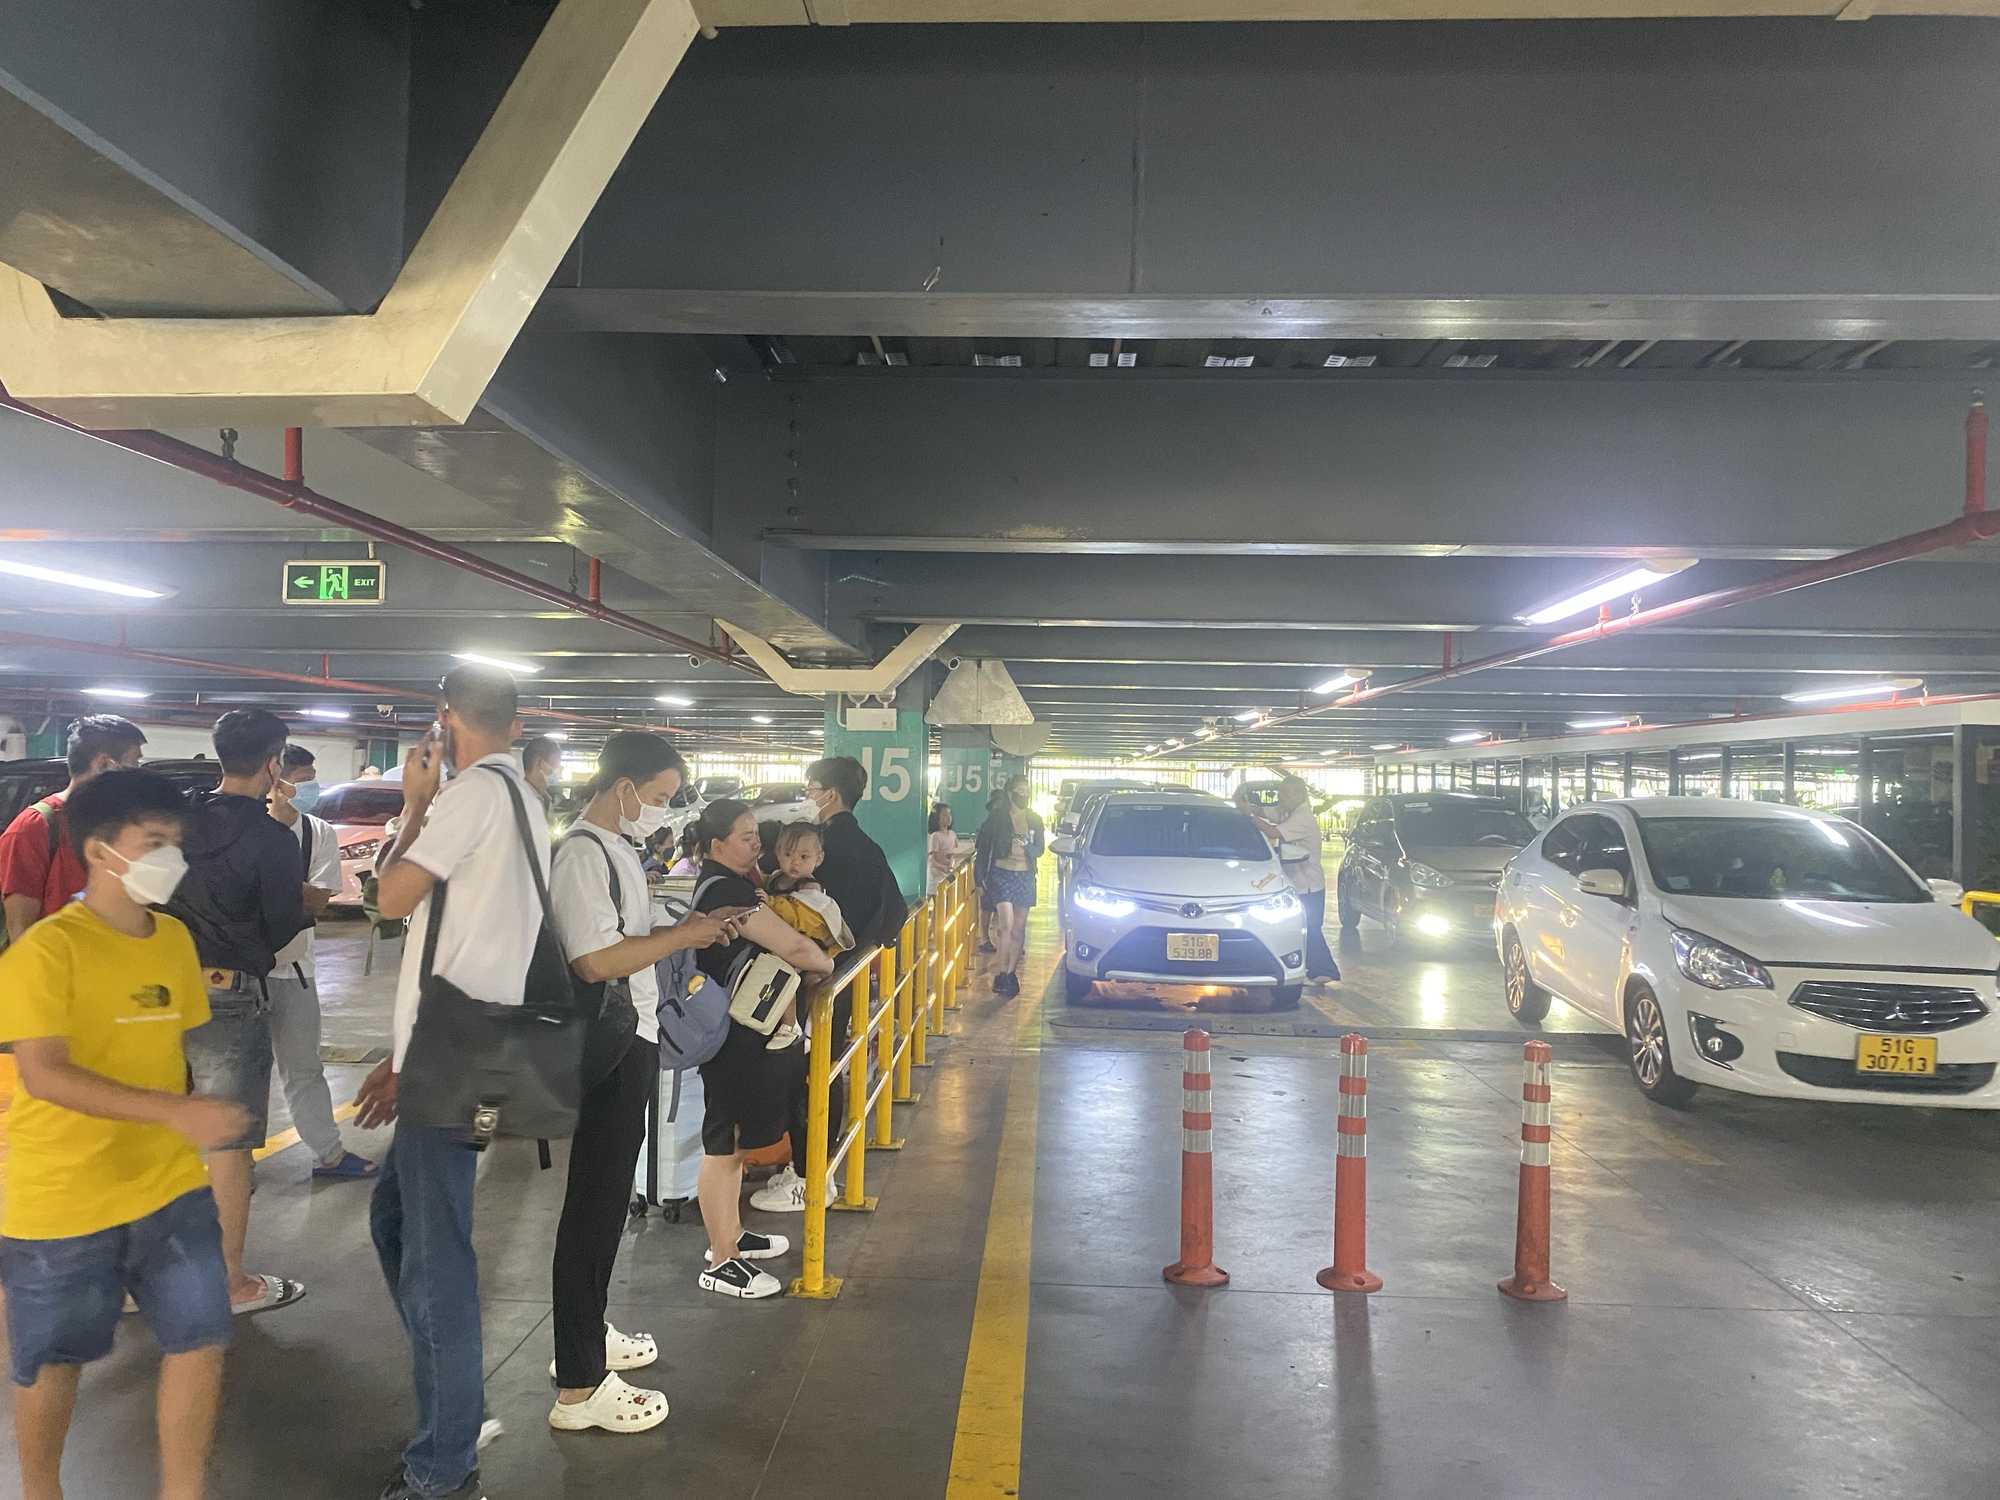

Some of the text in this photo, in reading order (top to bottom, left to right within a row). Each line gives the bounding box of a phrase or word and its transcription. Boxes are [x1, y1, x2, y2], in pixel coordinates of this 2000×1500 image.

[354, 578, 376, 587] EXIT
[947, 764, 982, 793] J5
[1182, 936, 1204, 947] 51G
[1881, 1038, 1915, 1054] 51G
[1866, 1054, 1927, 1072] 307.13
